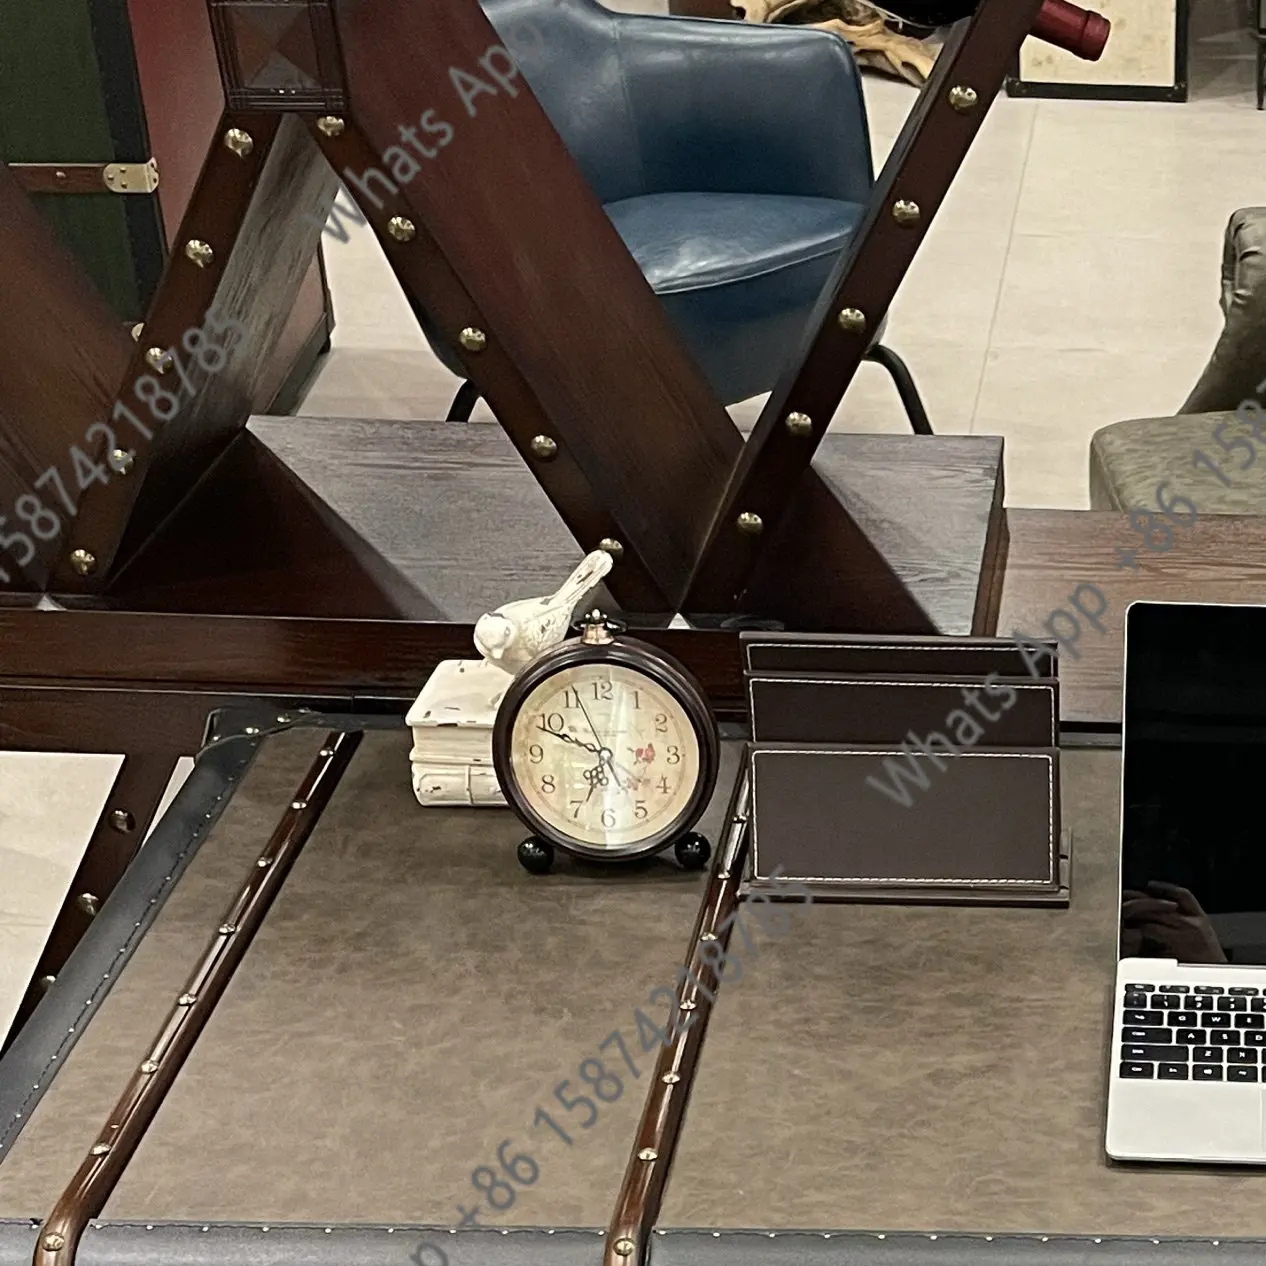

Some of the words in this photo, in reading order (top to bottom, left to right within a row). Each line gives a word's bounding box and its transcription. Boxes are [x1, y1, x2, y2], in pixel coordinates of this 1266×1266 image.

[591, 681, 614, 701] 12
[538, 712, 565, 732] 10
[655, 713, 669, 733] 2
[529, 744, 545, 765] 9
[666, 745, 681, 765] 3
[541, 774, 556, 794] 8
[655, 775, 672, 795] 4
[569, 800, 584, 819] 7
[600, 808, 617, 828] 6
[634, 800, 649, 820] 5
